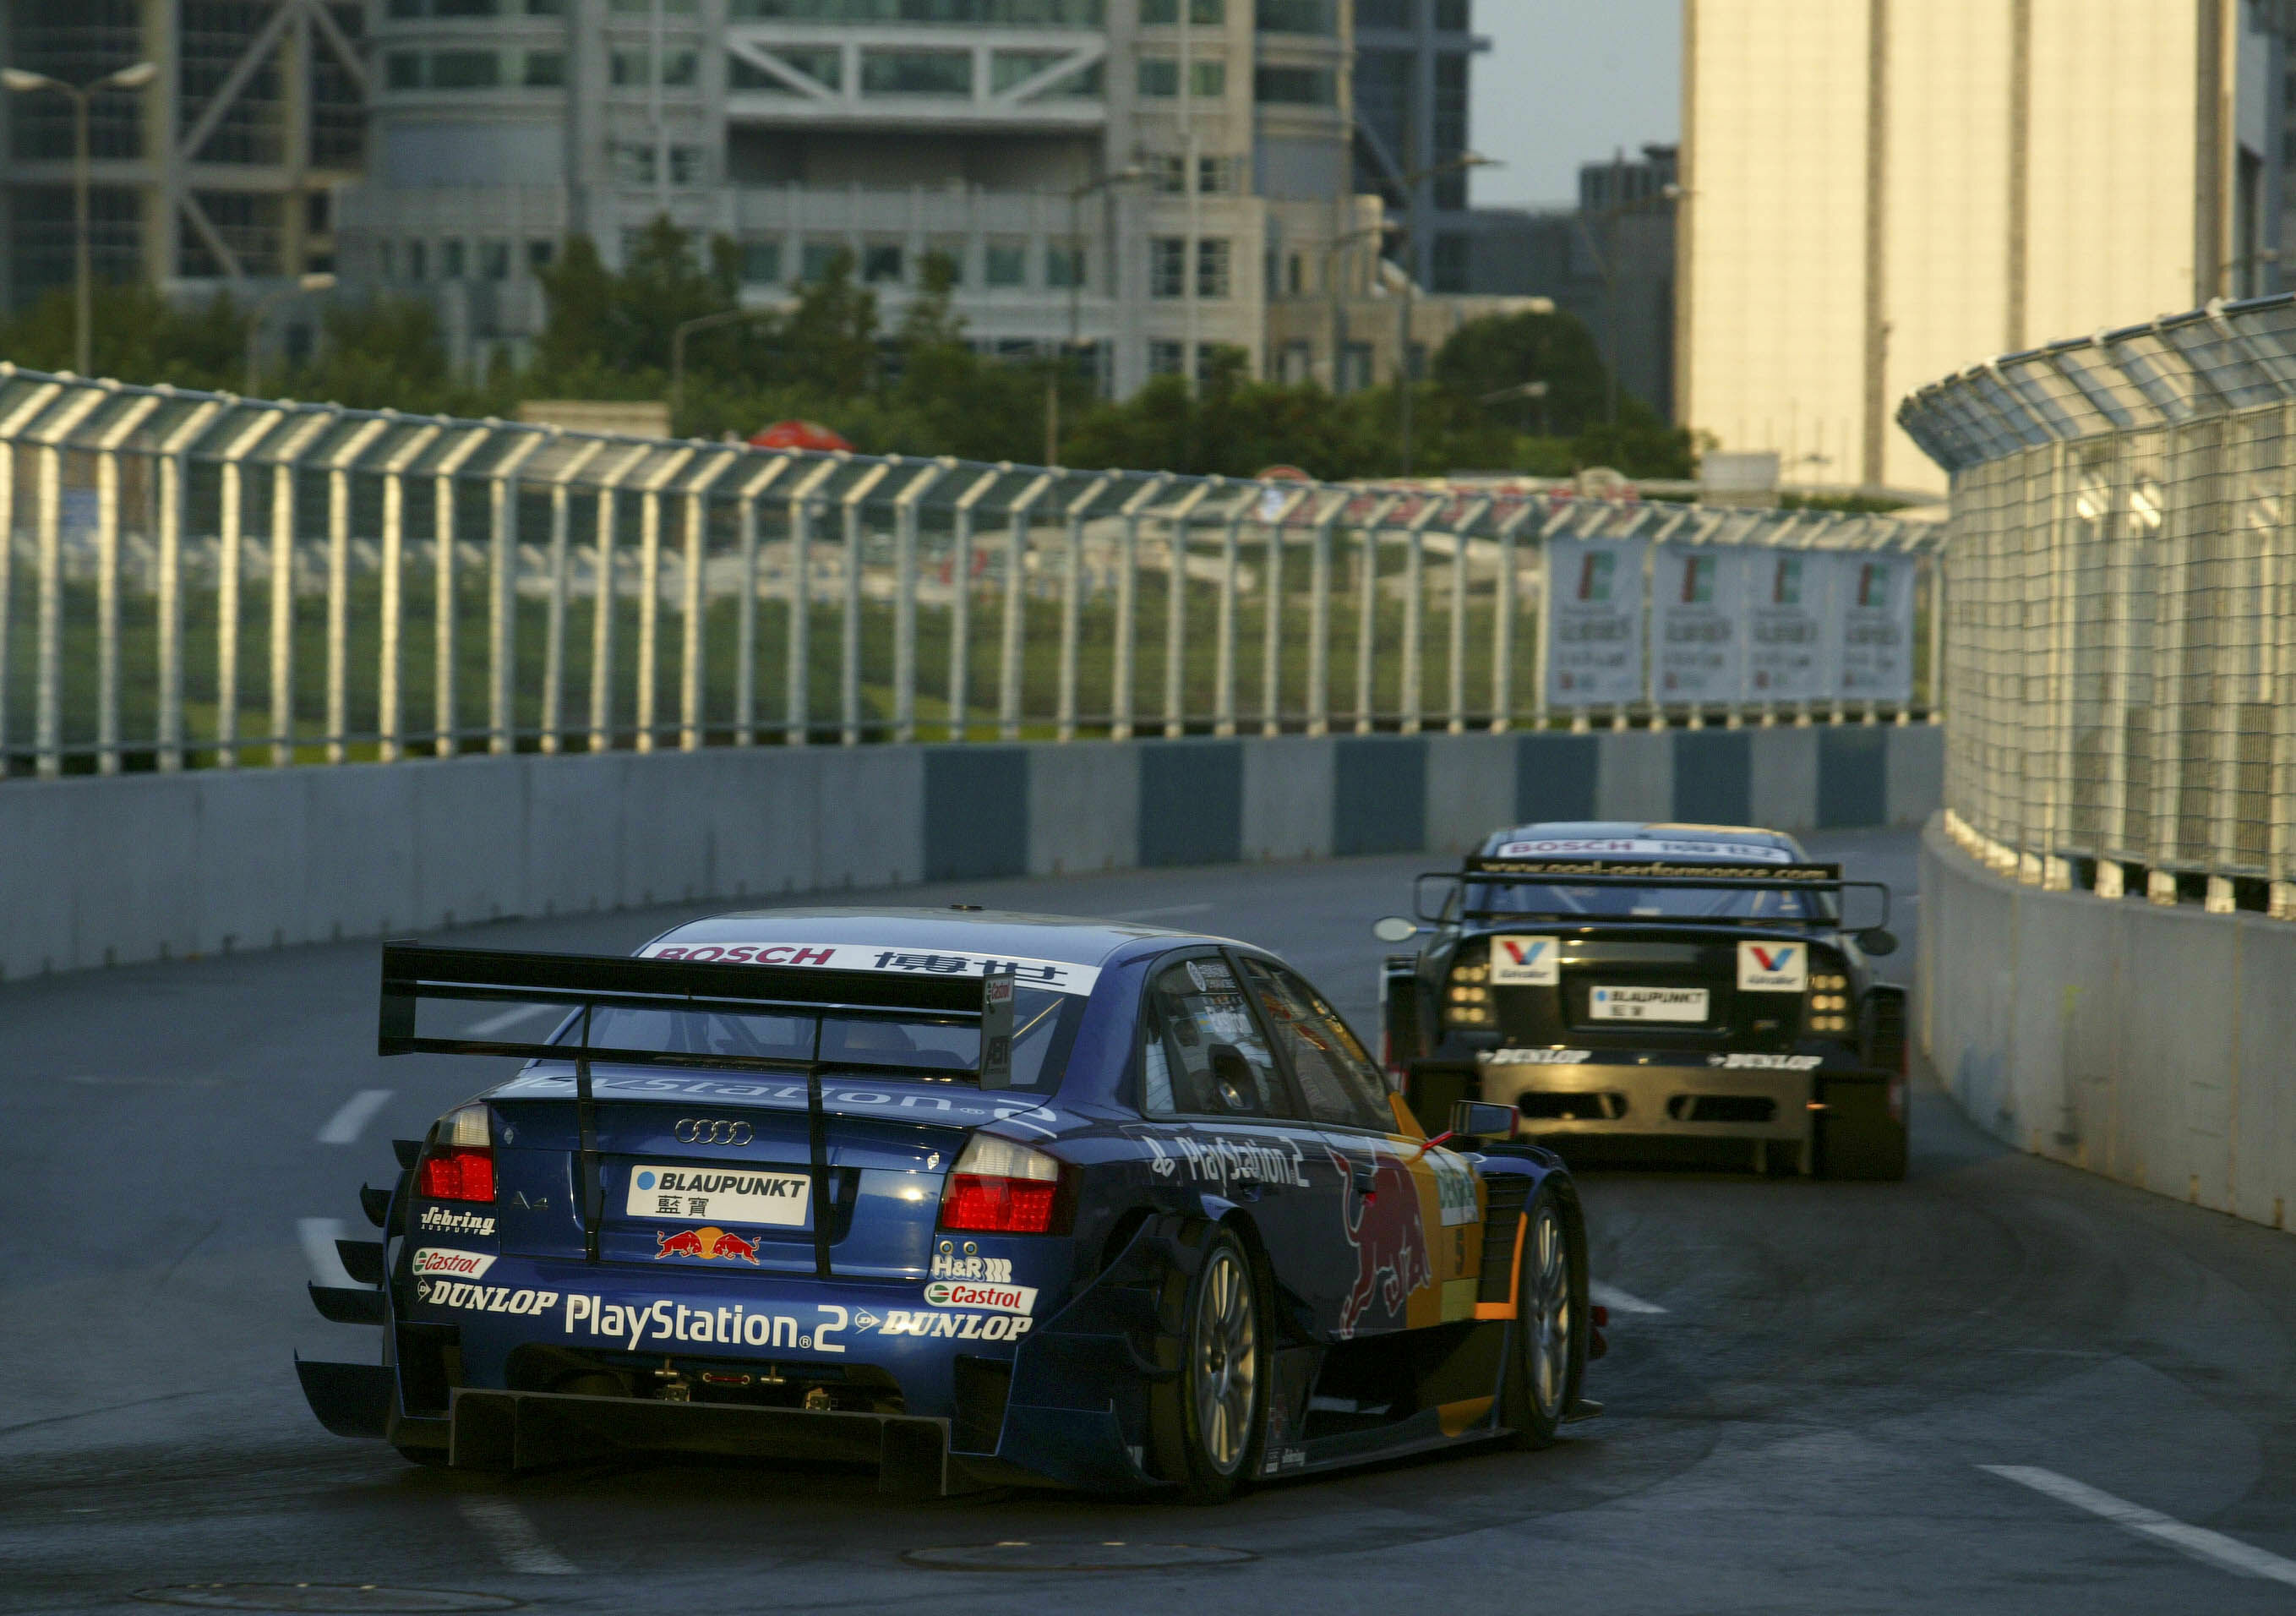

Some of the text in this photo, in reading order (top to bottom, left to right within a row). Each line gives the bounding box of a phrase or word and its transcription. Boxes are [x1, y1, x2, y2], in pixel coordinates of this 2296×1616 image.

[1510, 841, 1633, 854] BOSCH
[657, 947, 836, 965] BOSCH
[1609, 991, 1703, 1003] BLAUPUNKT
[658, 1172, 806, 1198] BLAUPUNKT
[421, 1207, 495, 1237] Sebring
[425, 1252, 482, 1274] Castrol
[931, 1254, 985, 1281] H&R
[428, 1280, 559, 1316] DUNLOP
[952, 1286, 1022, 1308] Castrol
[879, 1310, 1033, 1341] DUNLOP
